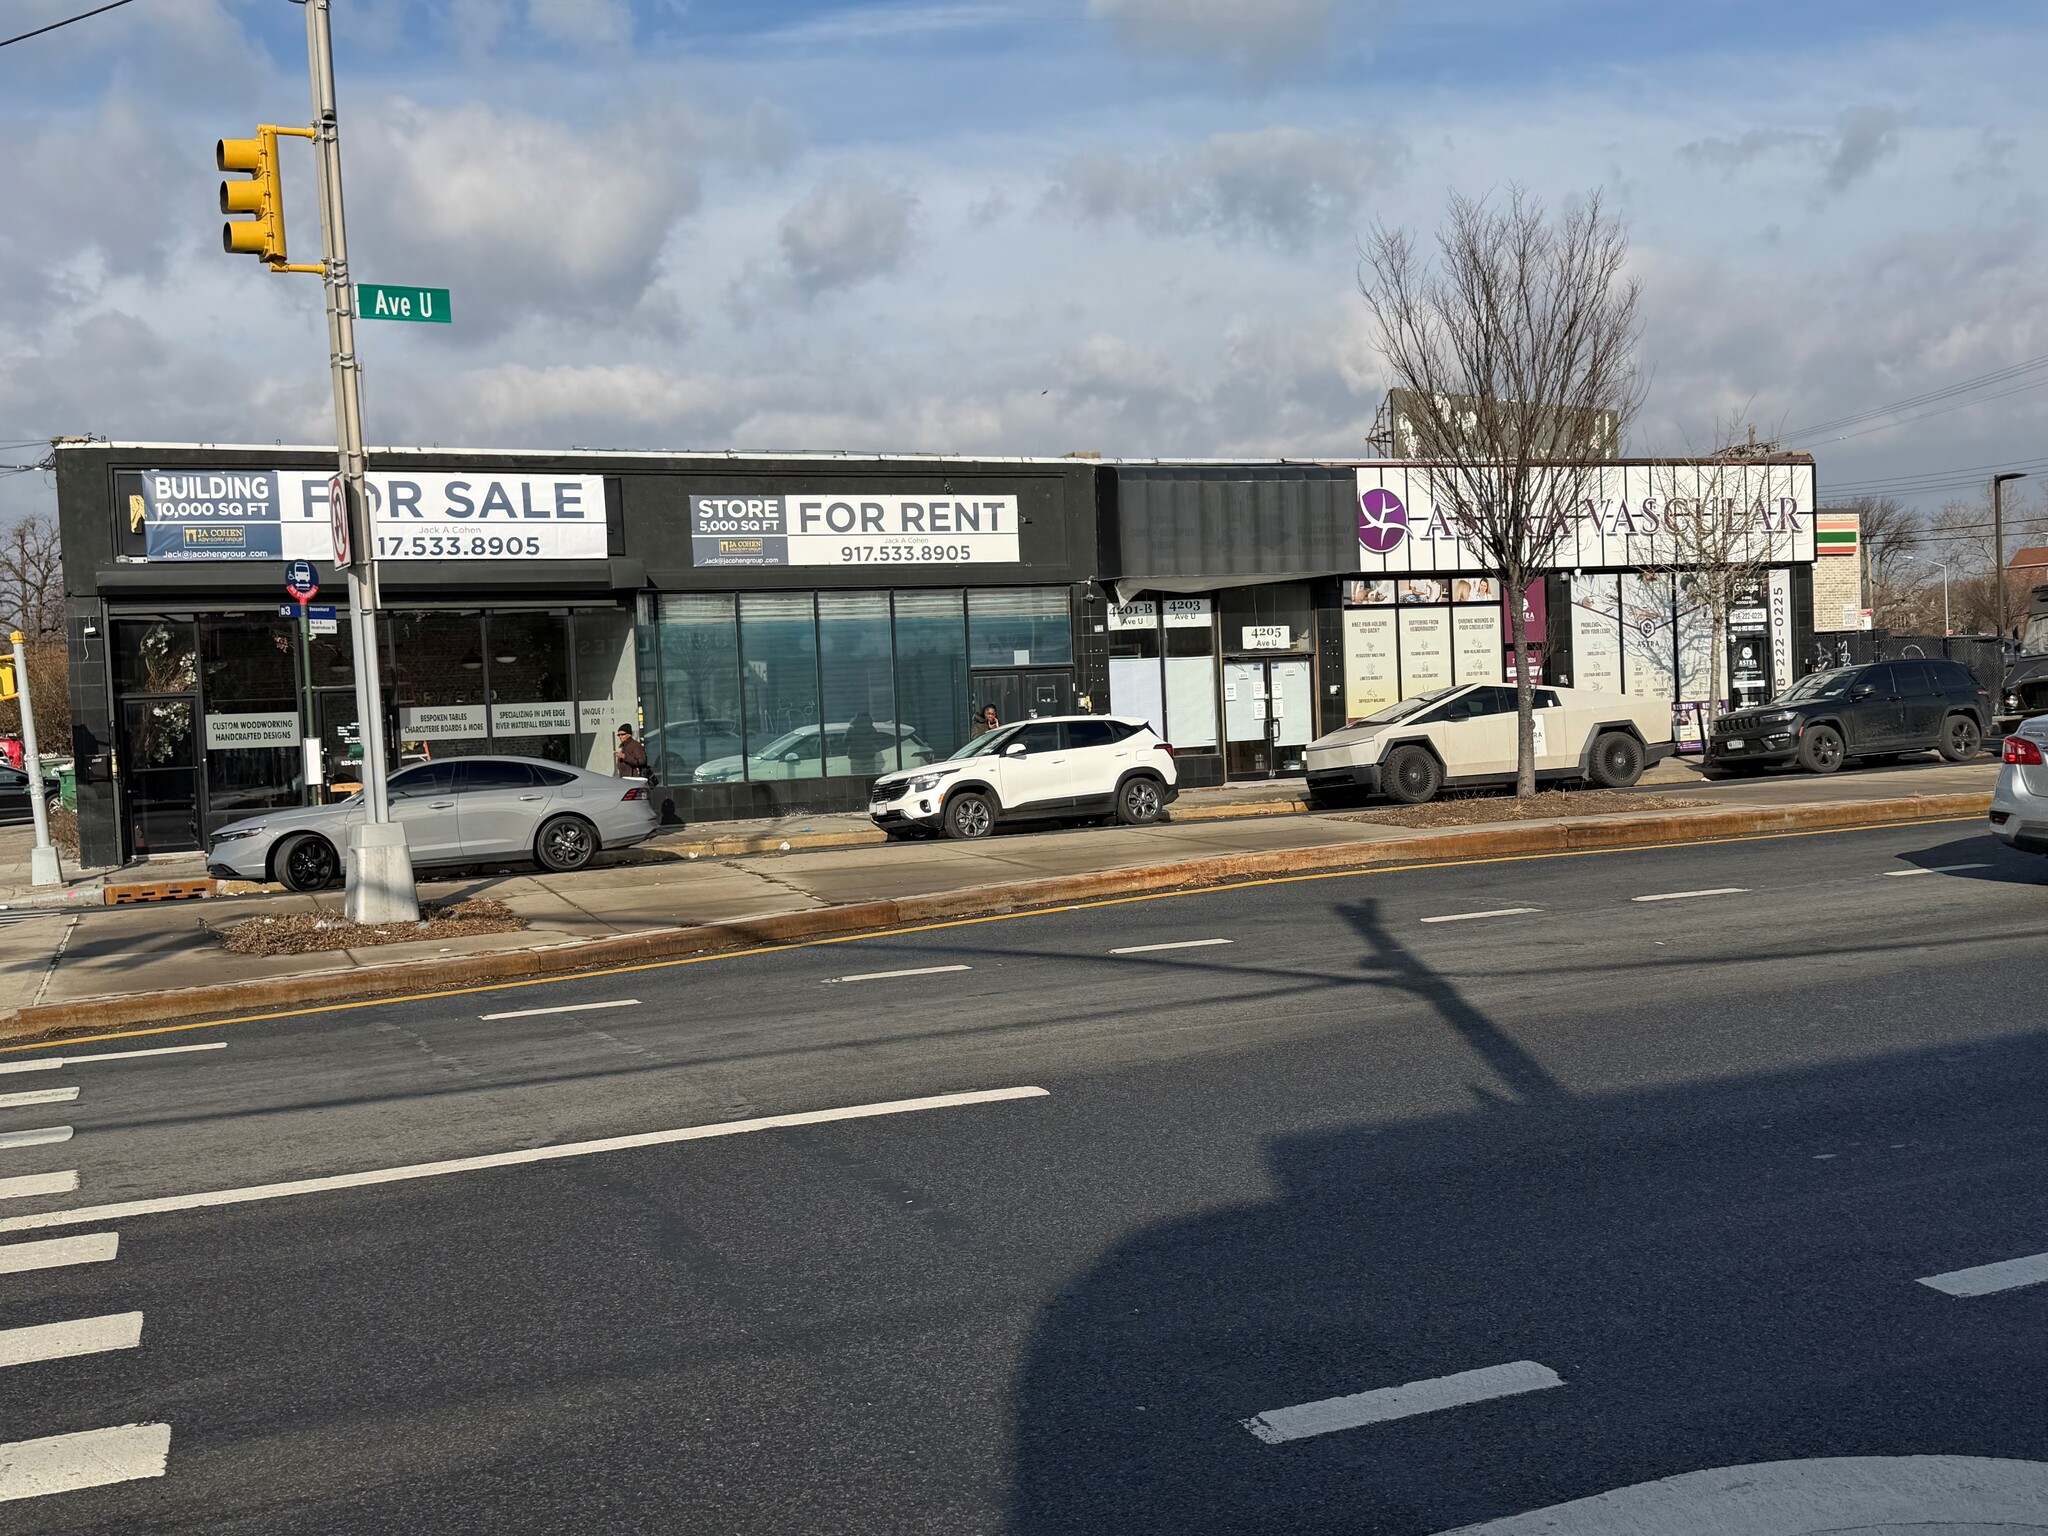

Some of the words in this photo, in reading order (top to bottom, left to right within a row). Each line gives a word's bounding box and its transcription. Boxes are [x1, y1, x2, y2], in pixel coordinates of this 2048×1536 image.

[374, 290, 411, 317] Ave
[420, 292, 432, 317] U
[156, 477, 269, 499] BUILDING
[445, 481, 585, 519] SALE
[156, 503, 215, 518] 10,000
[219, 502, 244, 516] SQ
[248, 503, 269, 516] FT
[699, 500, 779, 518] STORE
[800, 502, 886, 533] FOR
[901, 502, 1006, 532] RENT
[1420, 500, 1572, 540] ASRA
[1584, 497, 1802, 535] VASCULAR
[700, 521, 738, 533] 5,000
[741, 520, 760, 531] SQ
[763, 520, 779, 531] FT
[198, 529, 209, 538] JA
[211, 529, 243, 538] COHEN
[378, 537, 540, 556] 17.533.8905
[841, 546, 971, 562] 917.533.8905
[281, 606, 291, 616] B3
[1109, 603, 1153, 617] 4201-B
[1169, 601, 1201, 612] 4203
[1251, 628, 1282, 638] 4205
[1774, 587, 1786, 697] 18-222-0225
[449, 713, 467, 721] TABLES
[500, 710, 533, 719] SPECIALIZING
[541, 709, 552, 717] LIVE
[553, 709, 566, 717] EDGE
[213, 722, 239, 730] CUSTOM
[241, 720, 293, 729] WOODWORKING
[405, 725, 440, 733] CHARCUTERIE
[441, 724, 462, 732] BOARDS
[469, 723, 484, 731] MORE
[511, 721, 537, 729] WATERFALL
[539, 720, 553, 728] RESIN
[216, 732, 262, 741] HANDCRAFTED
[264, 731, 291, 740] DESIGNS
